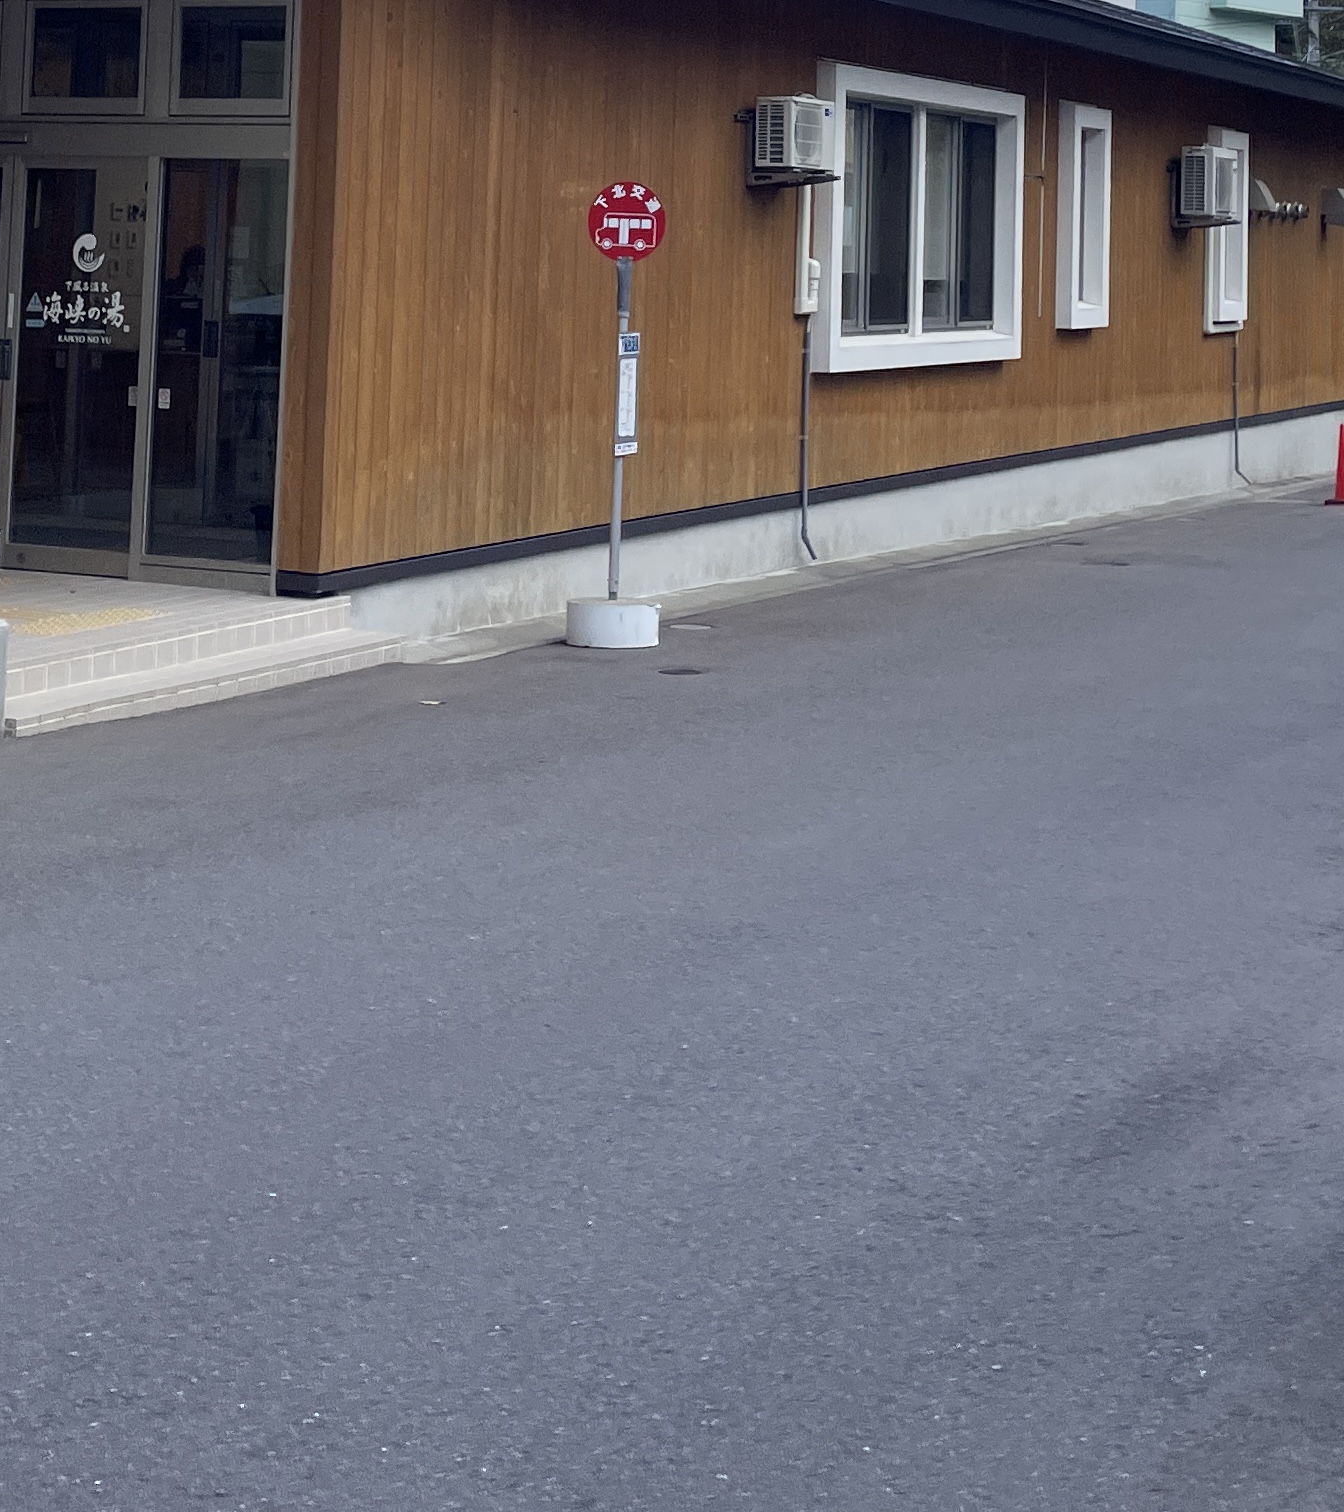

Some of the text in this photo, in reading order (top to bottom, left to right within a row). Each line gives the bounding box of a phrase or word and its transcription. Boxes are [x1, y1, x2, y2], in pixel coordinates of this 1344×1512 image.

[43, 291, 125, 328] 海峡の湯
[57, 334, 112, 345] KAIKYO NO YU
